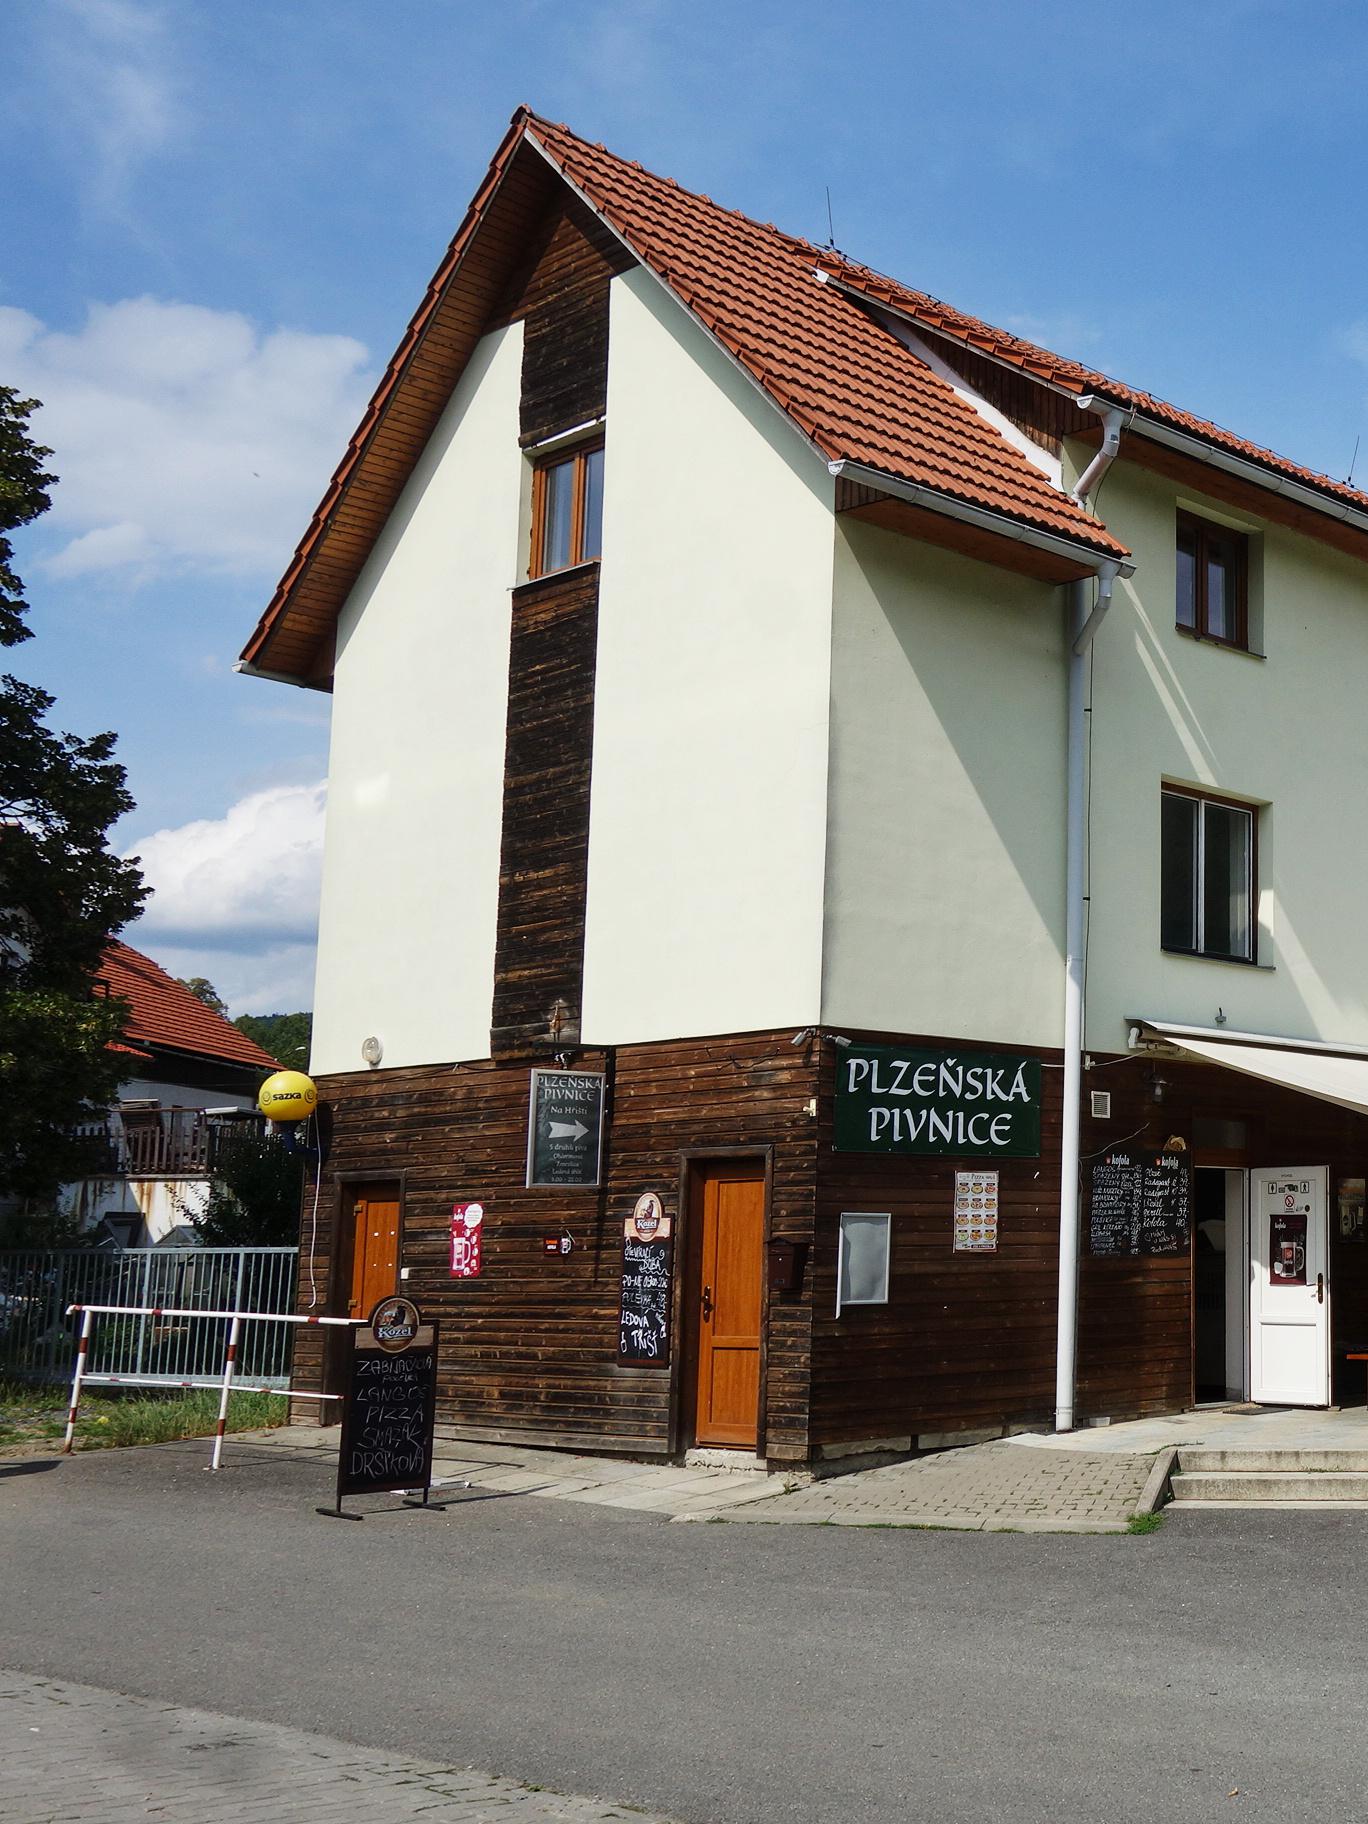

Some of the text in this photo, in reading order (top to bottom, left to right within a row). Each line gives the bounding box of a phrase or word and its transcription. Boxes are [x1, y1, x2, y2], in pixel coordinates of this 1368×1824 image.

[846, 1057, 1031, 1103] PLZEŇSKÁ
[544, 1088, 596, 1101] PIVNICE
[550, 1105, 563, 1114] Na
[867, 1106, 1012, 1146] PIVNICE
[1111, 1154, 1130, 1168] kofola
[1161, 1156, 1179, 1170] kofola
[637, 1219, 657, 1229] Kozel
[620, 1309, 650, 1328] LEDOVÁ
[378, 1326, 413, 1339] Kozel
[365, 1403, 424, 1424] PIZZA
